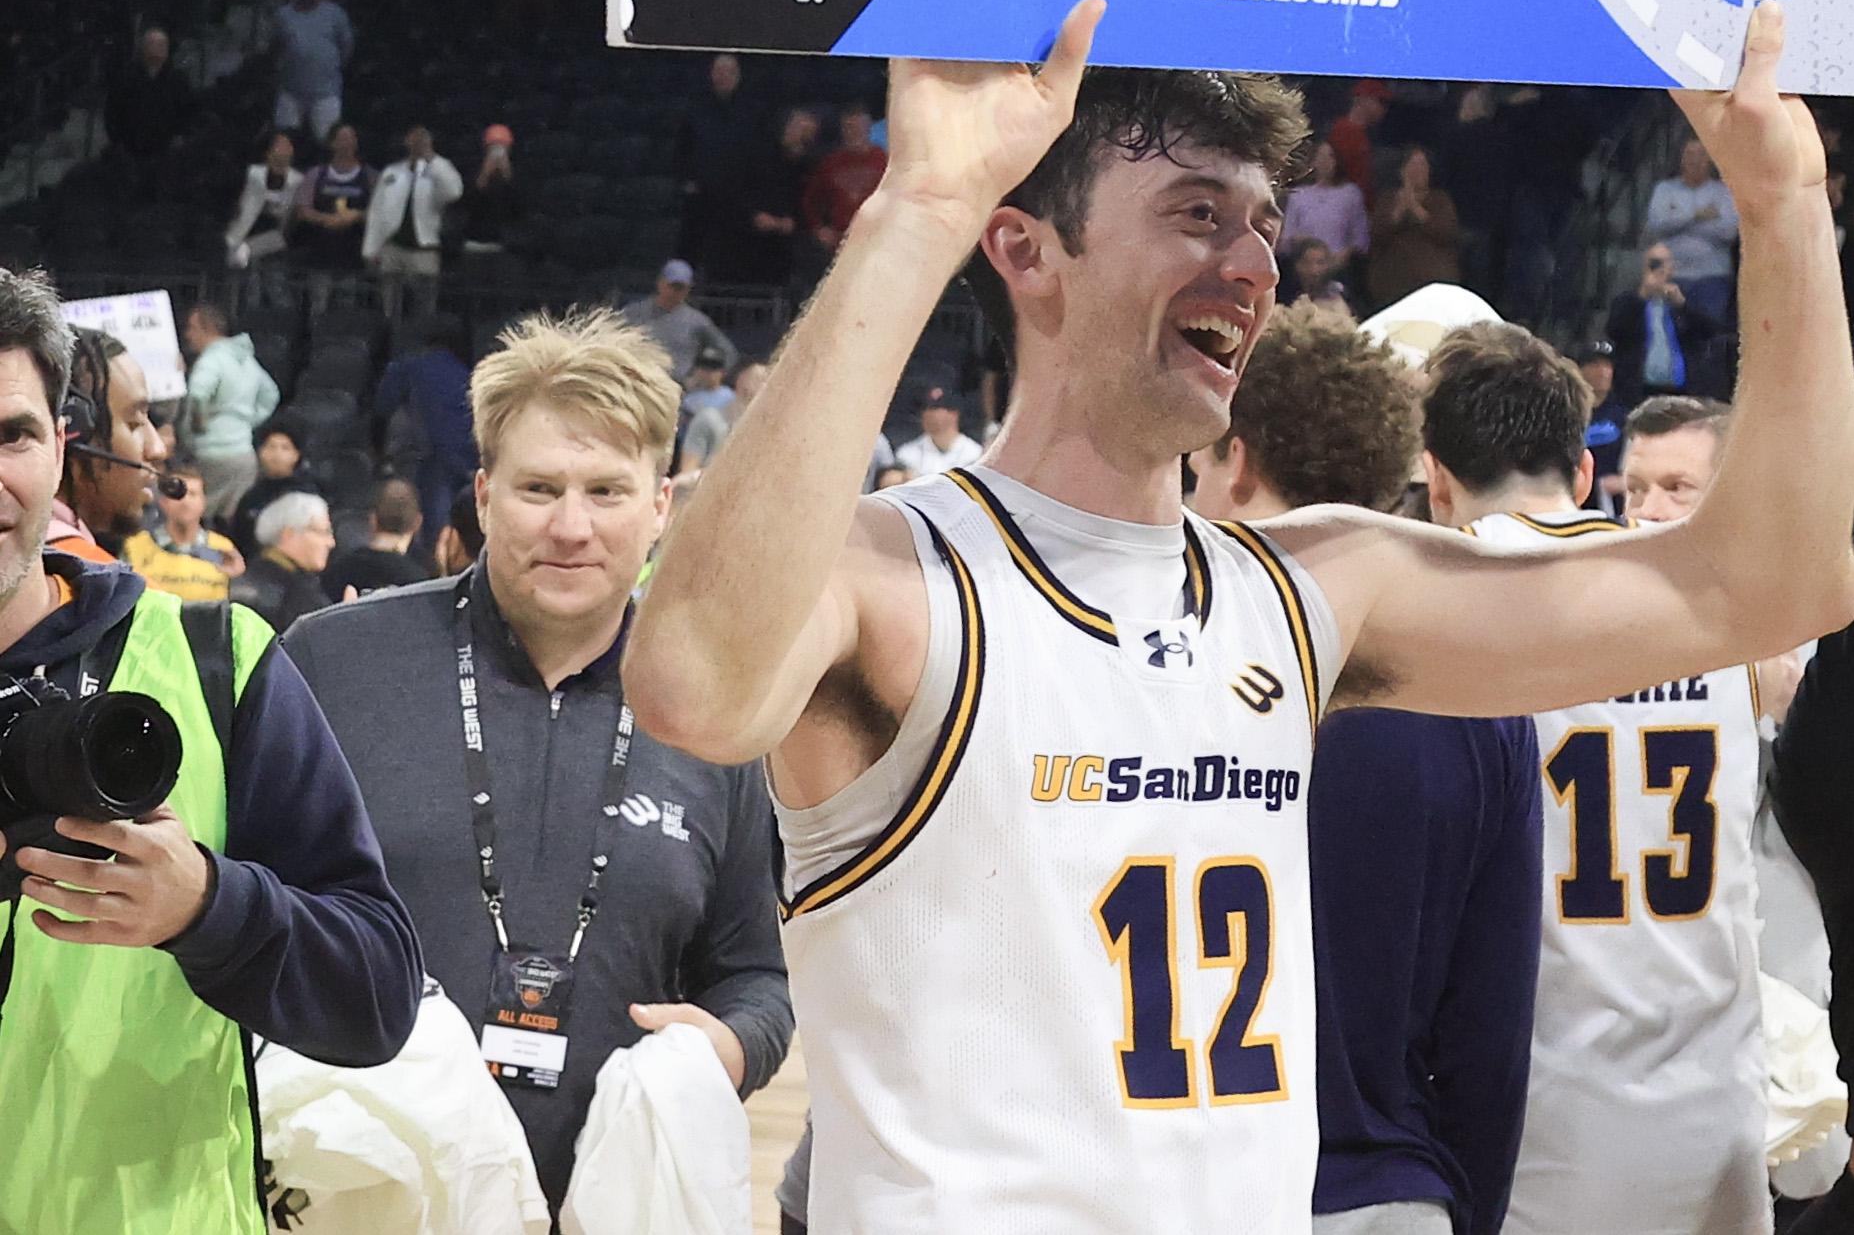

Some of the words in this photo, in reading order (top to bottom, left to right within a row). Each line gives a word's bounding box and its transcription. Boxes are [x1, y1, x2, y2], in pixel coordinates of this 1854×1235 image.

[457, 643, 475, 675] THE
[459, 676, 478, 707] BIG
[463, 707, 484, 753] WEST
[612, 734, 632, 767] THE
[1541, 724, 1720, 926] 13
[1091, 854, 1290, 1109] 12
[497, 1009, 516, 1024] ALL
